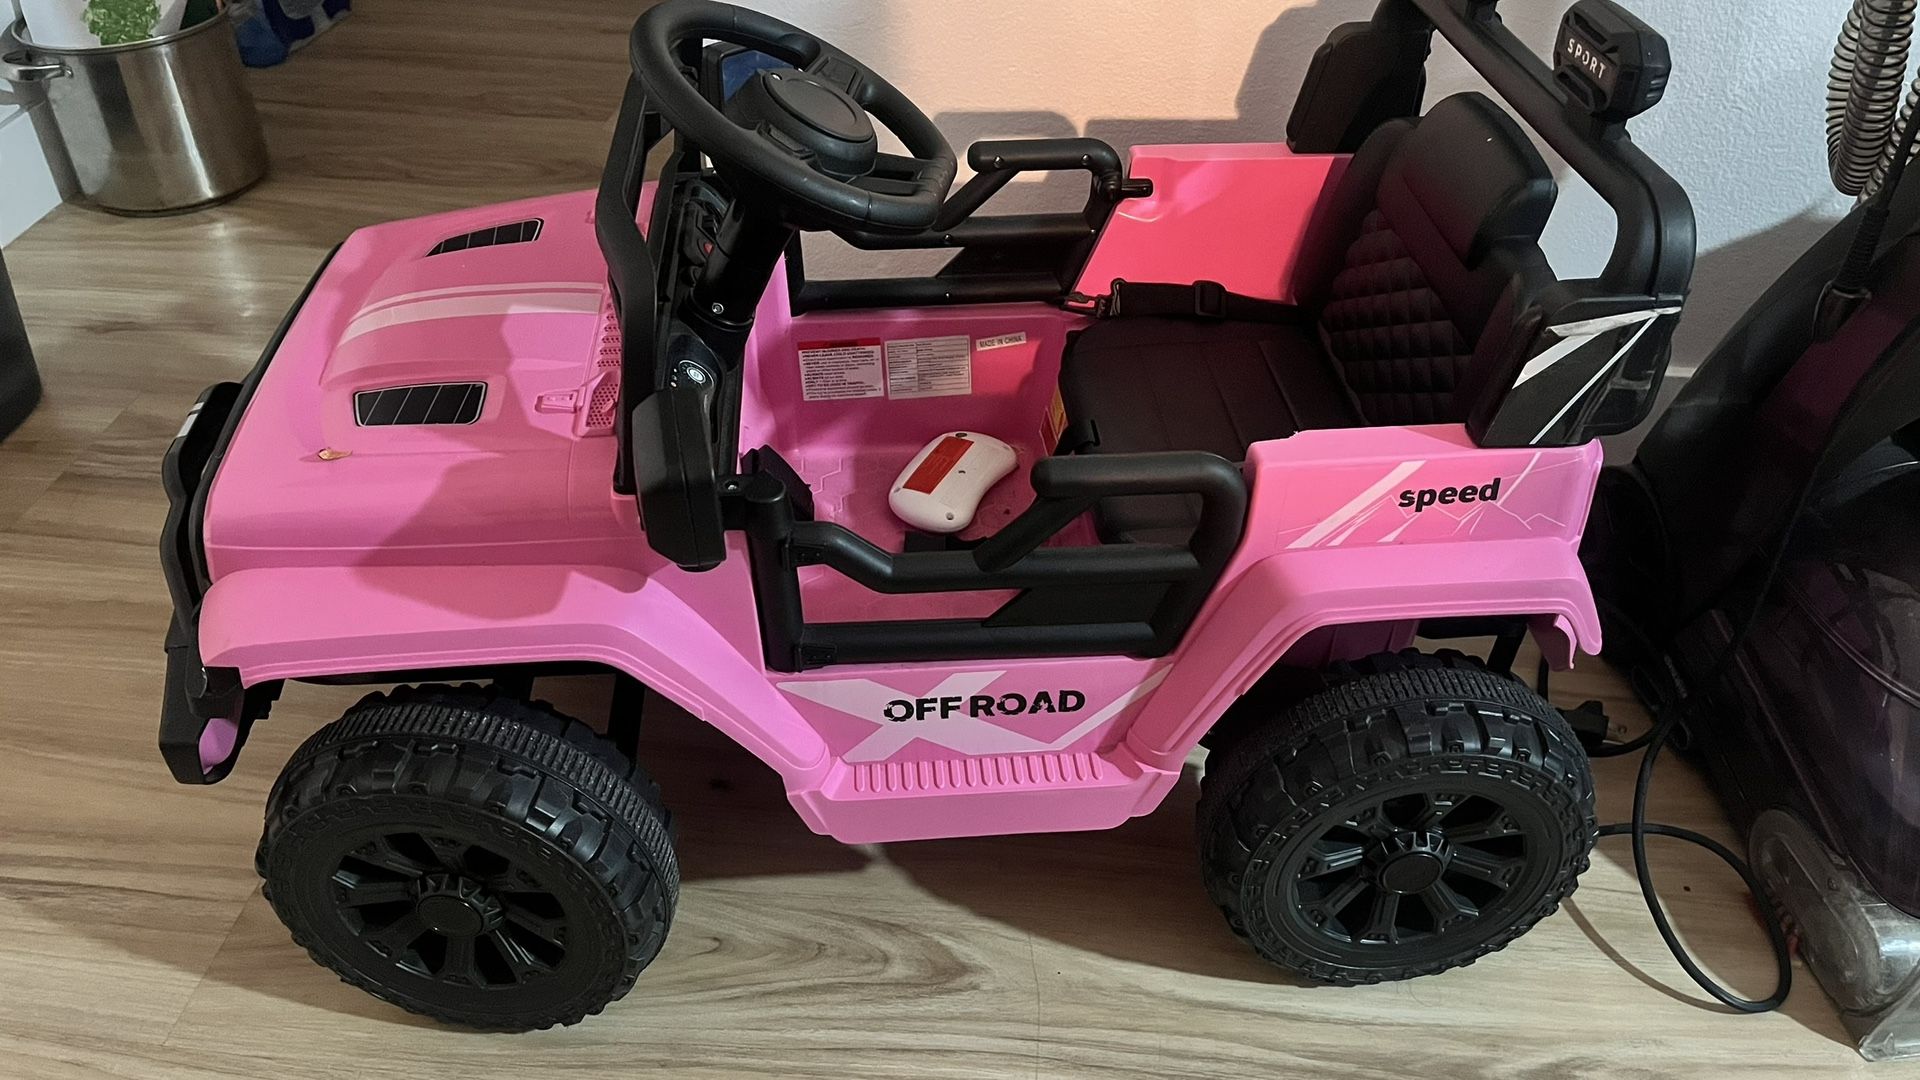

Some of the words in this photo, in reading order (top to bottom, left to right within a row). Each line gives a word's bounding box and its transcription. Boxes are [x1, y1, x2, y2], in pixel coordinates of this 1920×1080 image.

[1567, 38, 1607, 78] SPORT
[979, 339, 996, 347] MADE
[1004, 335, 1022, 344] CHINA
[1398, 477, 1501, 513] speed
[883, 696, 962, 722] OFF
[969, 690, 1086, 717] ROAD
